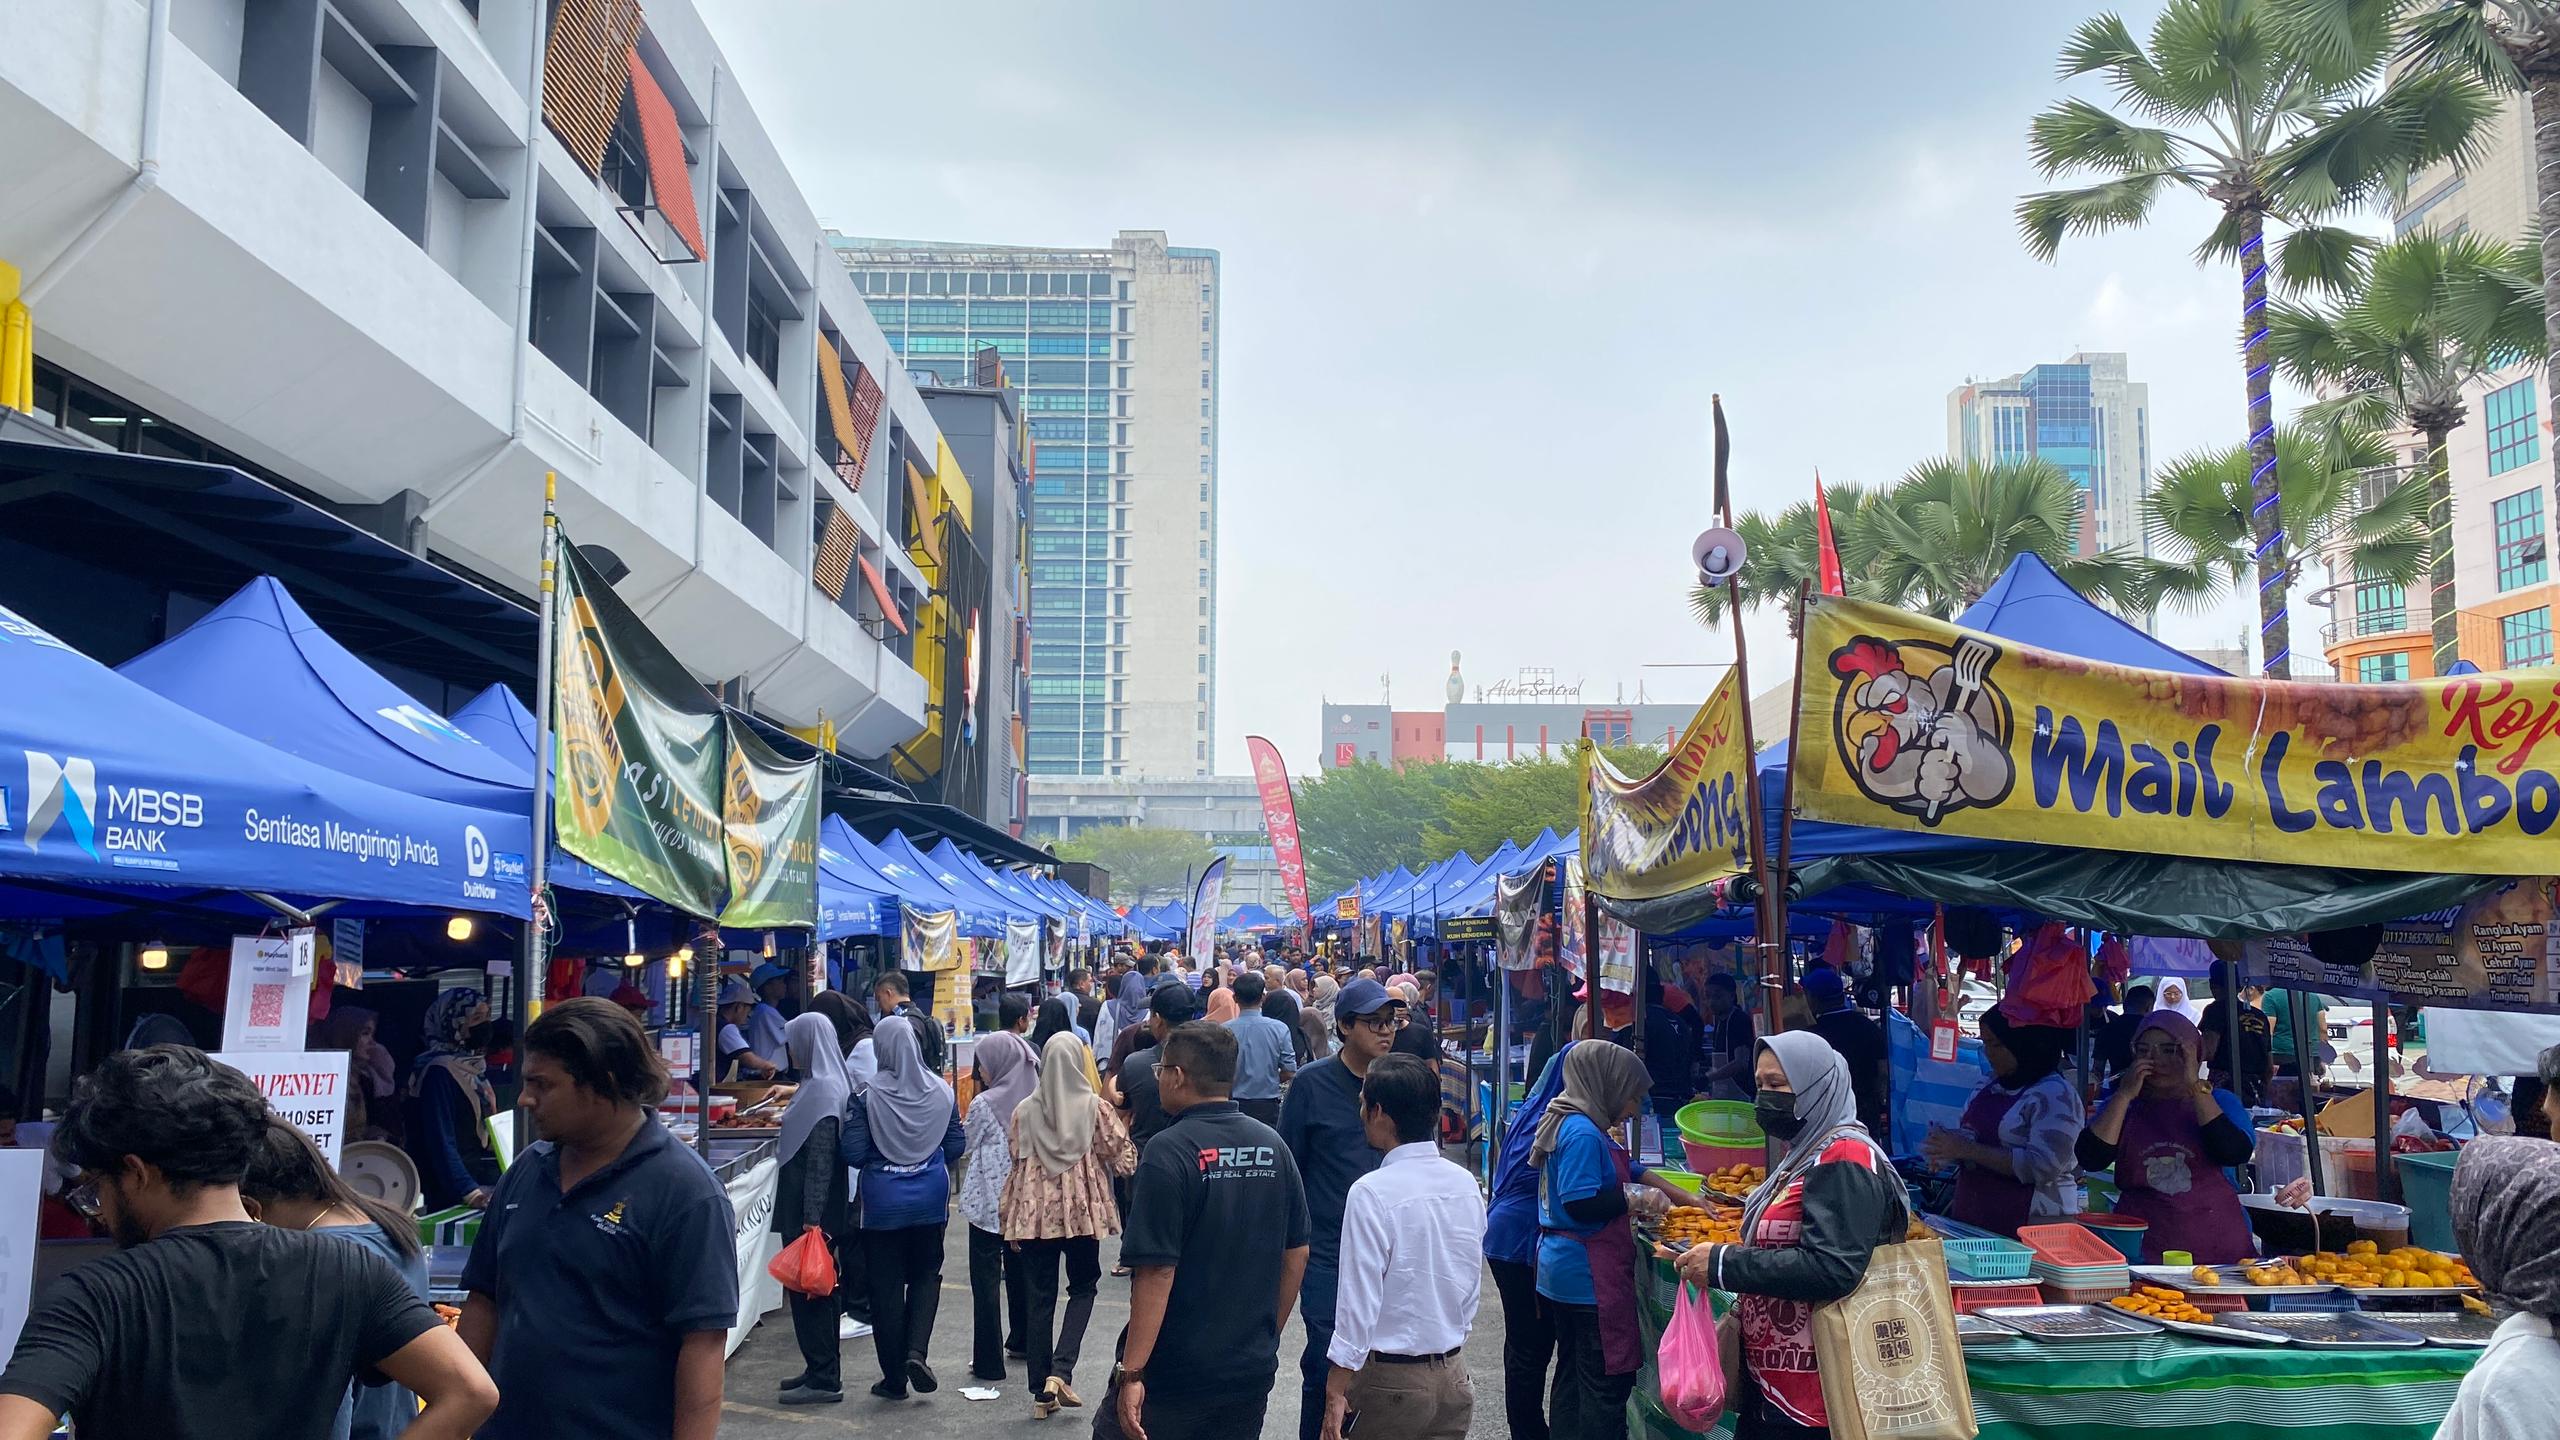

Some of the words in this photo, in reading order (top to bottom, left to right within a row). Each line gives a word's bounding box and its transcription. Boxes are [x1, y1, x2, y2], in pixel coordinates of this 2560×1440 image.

[2030, 704, 2234, 819] Mail
[107, 784, 204, 828] MBSB
[105, 826, 167, 853] BANK
[244, 808, 321, 849] Sentiasa
[325, 821, 401, 867] Mengiringi
[404, 835, 440, 867] Anda
[463, 880, 497, 900] DuitNow
[2473, 925, 2512, 938] Rangka
[2513, 924, 2543, 937] Ayam
[298, 941, 309, 967] 18
[2478, 940, 2491, 953] Isi
[2492, 941, 2522, 954] Ayam
[2273, 953, 2300, 967] Panjang
[2436, 955, 2459, 966] RM2
[2483, 957, 2513, 969] Leher
[2513, 957, 2536, 971] Ayam
[2426, 970, 2452, 981] Galah
[2409, 984, 2433, 997] Harga
[2433, 985, 2469, 997] Pasaran
[268, 1073, 339, 1097] PENYET
[1198, 1146, 1275, 1171] PREC
